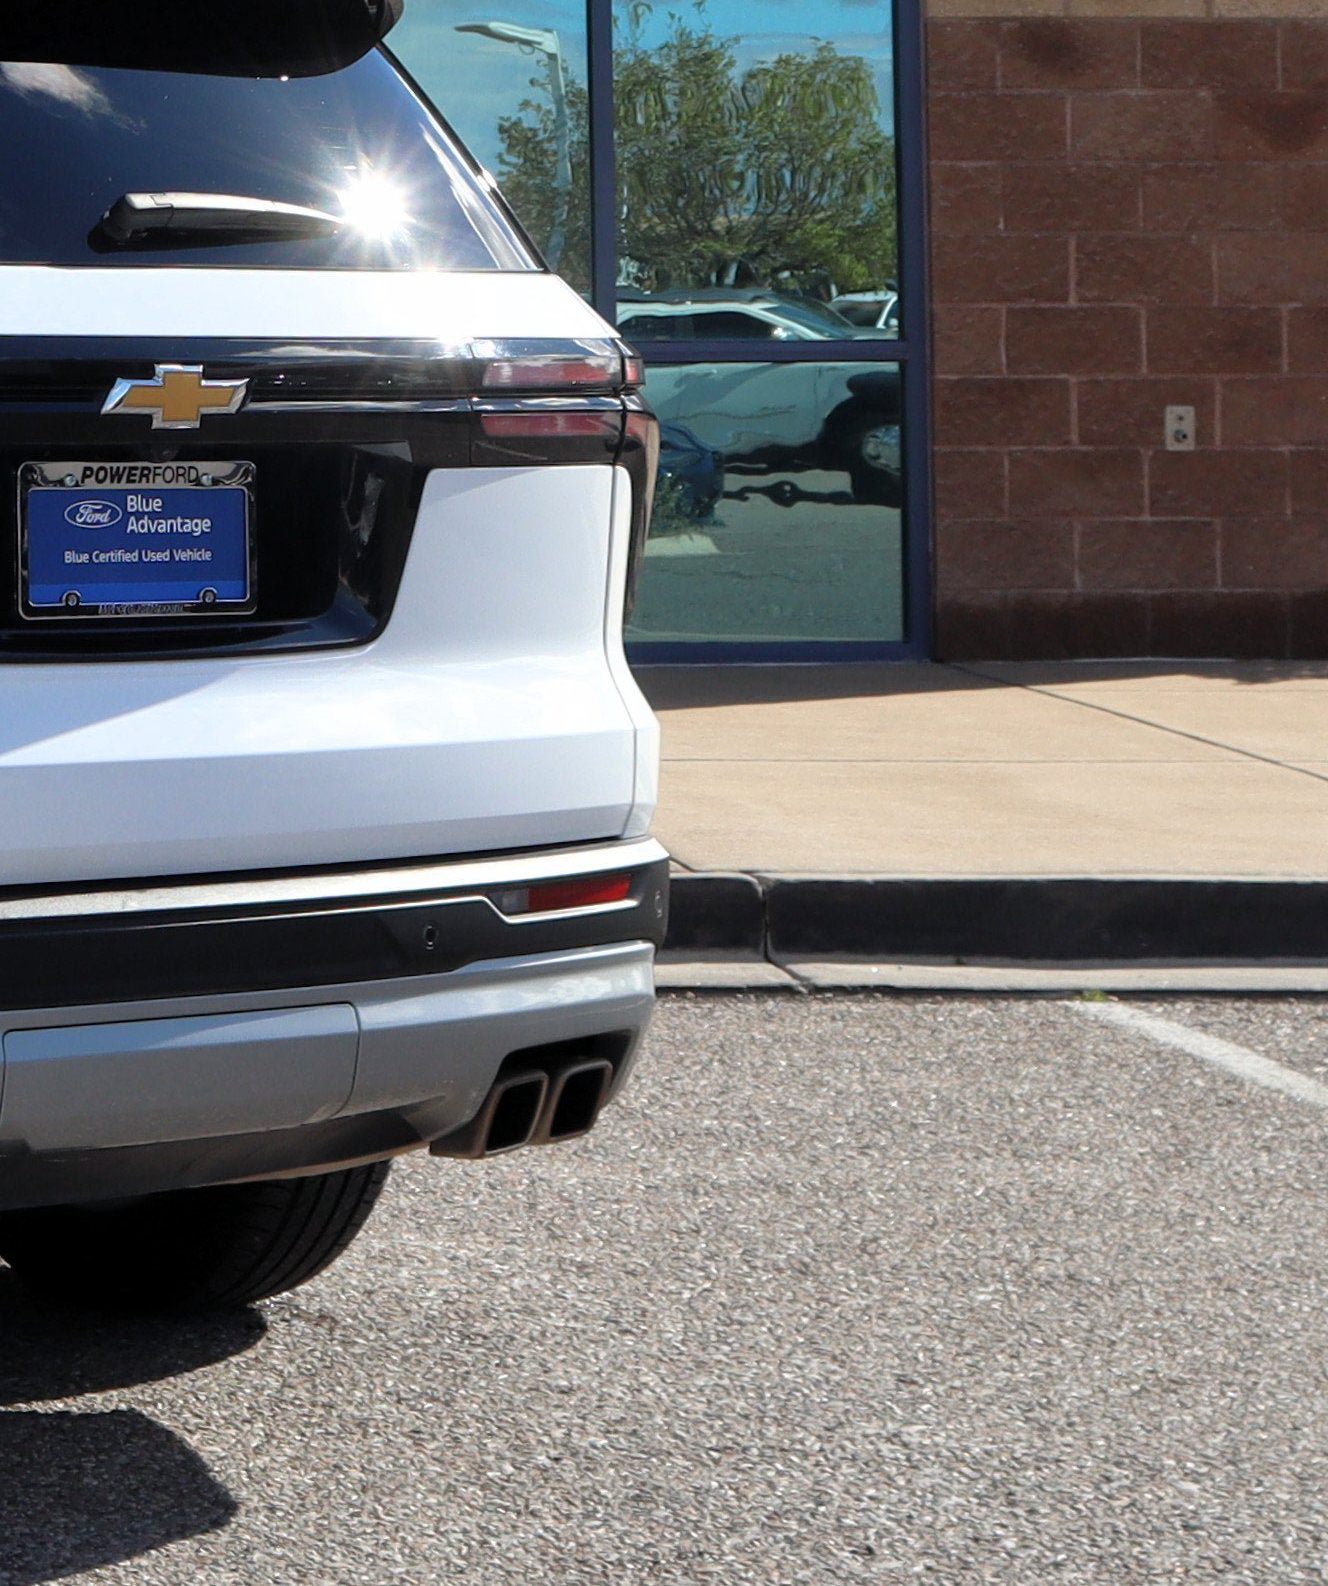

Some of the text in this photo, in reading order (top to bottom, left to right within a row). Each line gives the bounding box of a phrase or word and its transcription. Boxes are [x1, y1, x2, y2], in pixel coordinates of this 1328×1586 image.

[80, 465, 199, 485] POWERFORD
[126, 494, 163, 513] Blue
[75, 504, 112, 524] Ford
[126, 515, 212, 536] Advantage
[64, 548, 213, 563] Blue Certified Used Vehicle
